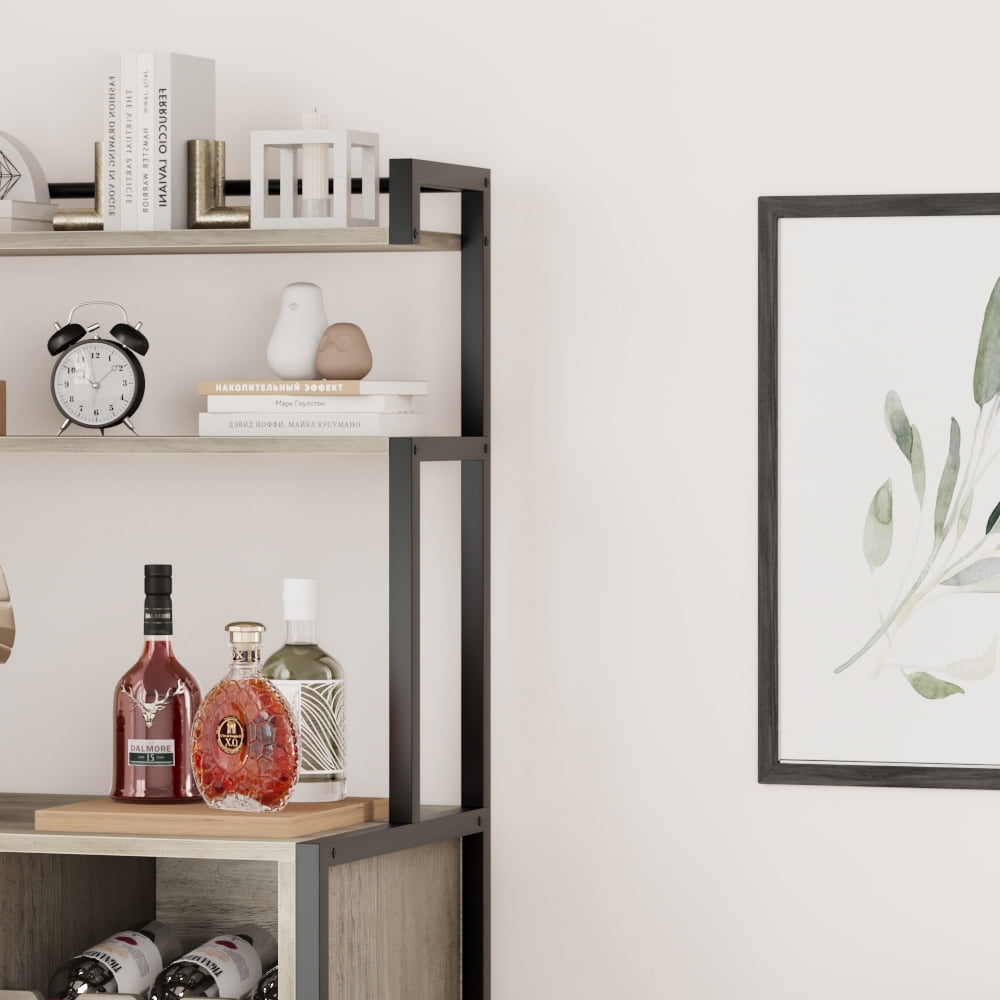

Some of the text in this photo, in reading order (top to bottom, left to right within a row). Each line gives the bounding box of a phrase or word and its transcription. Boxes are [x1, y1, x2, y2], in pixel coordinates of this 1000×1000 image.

[215, 382, 344, 392] НАКОПИТЕЛЬНЫЙ ЭФФЕКТ
[275, 400, 293, 409] Марк
[130, 744, 172, 752] DALMORE
[146, 754, 155, 762] 15
